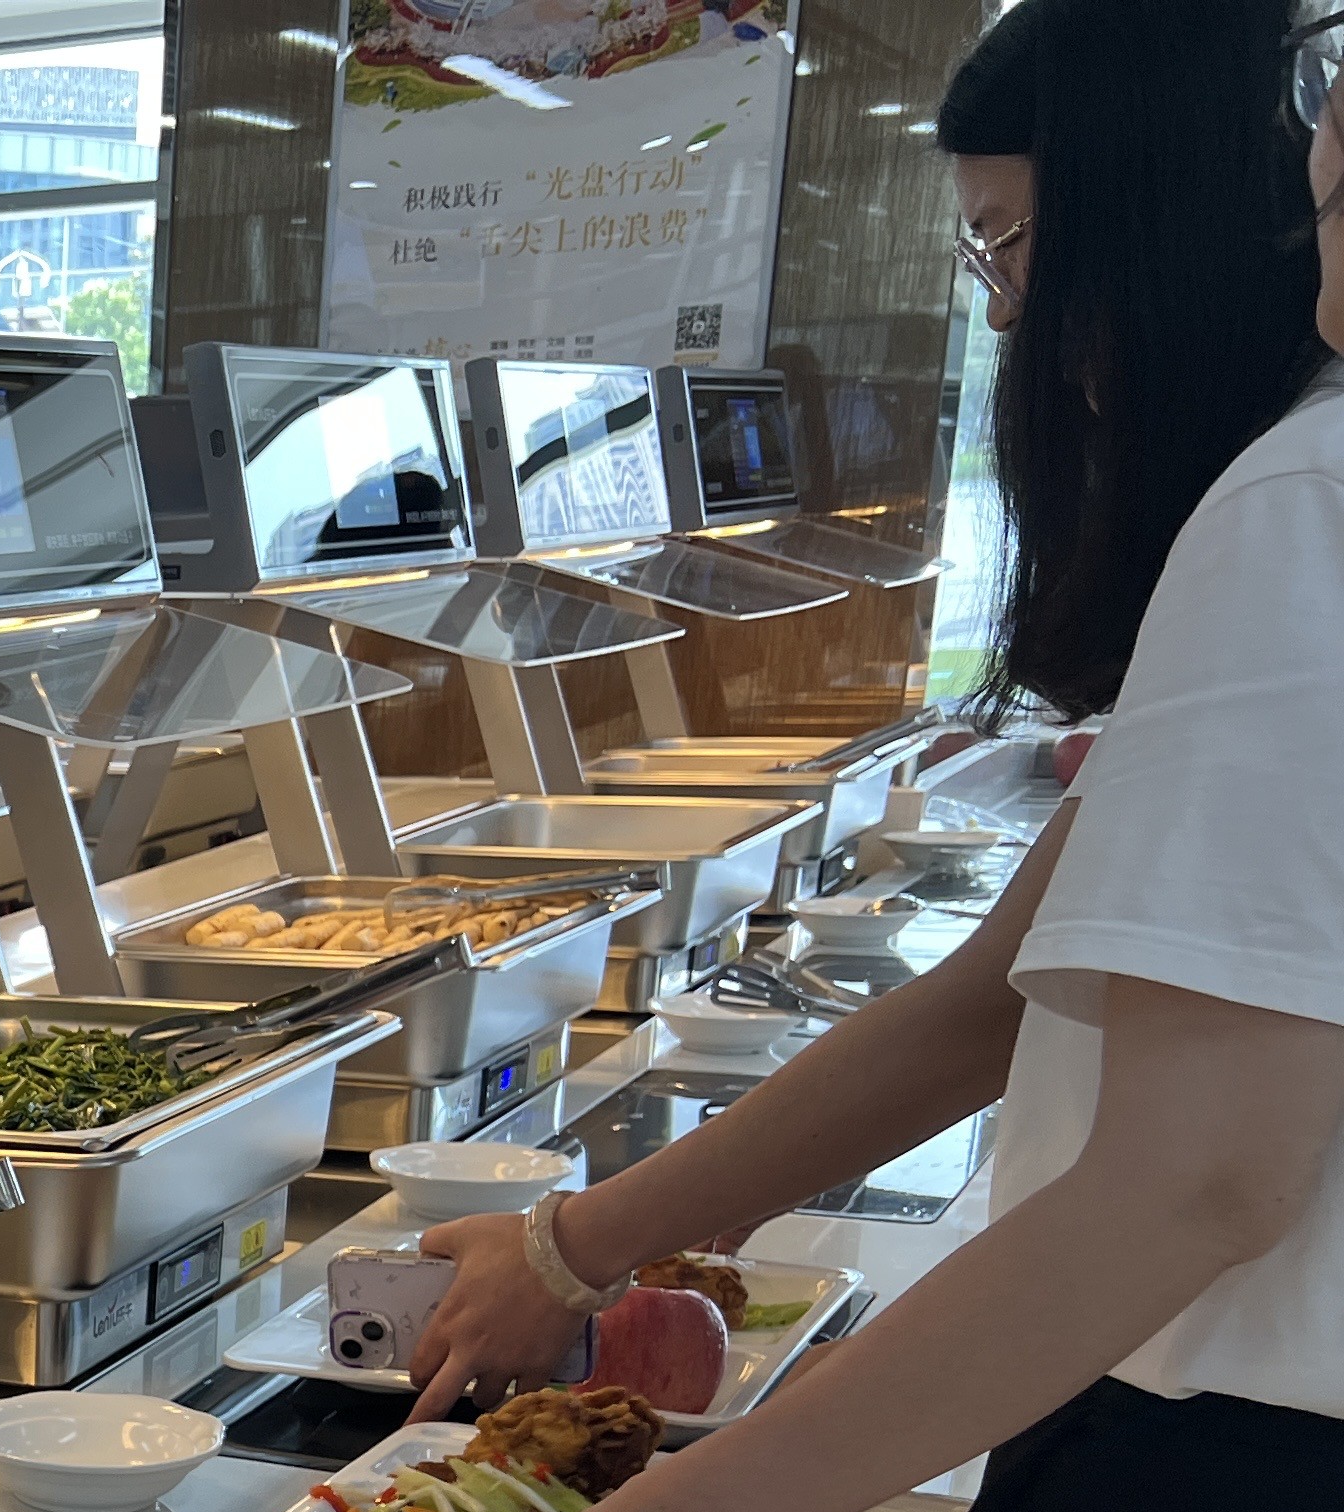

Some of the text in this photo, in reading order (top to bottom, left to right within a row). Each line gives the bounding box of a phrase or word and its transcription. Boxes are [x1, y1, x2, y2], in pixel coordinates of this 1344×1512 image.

[403, 180, 503, 213] 积极践行
[389, 237, 438, 265] 杜绝
